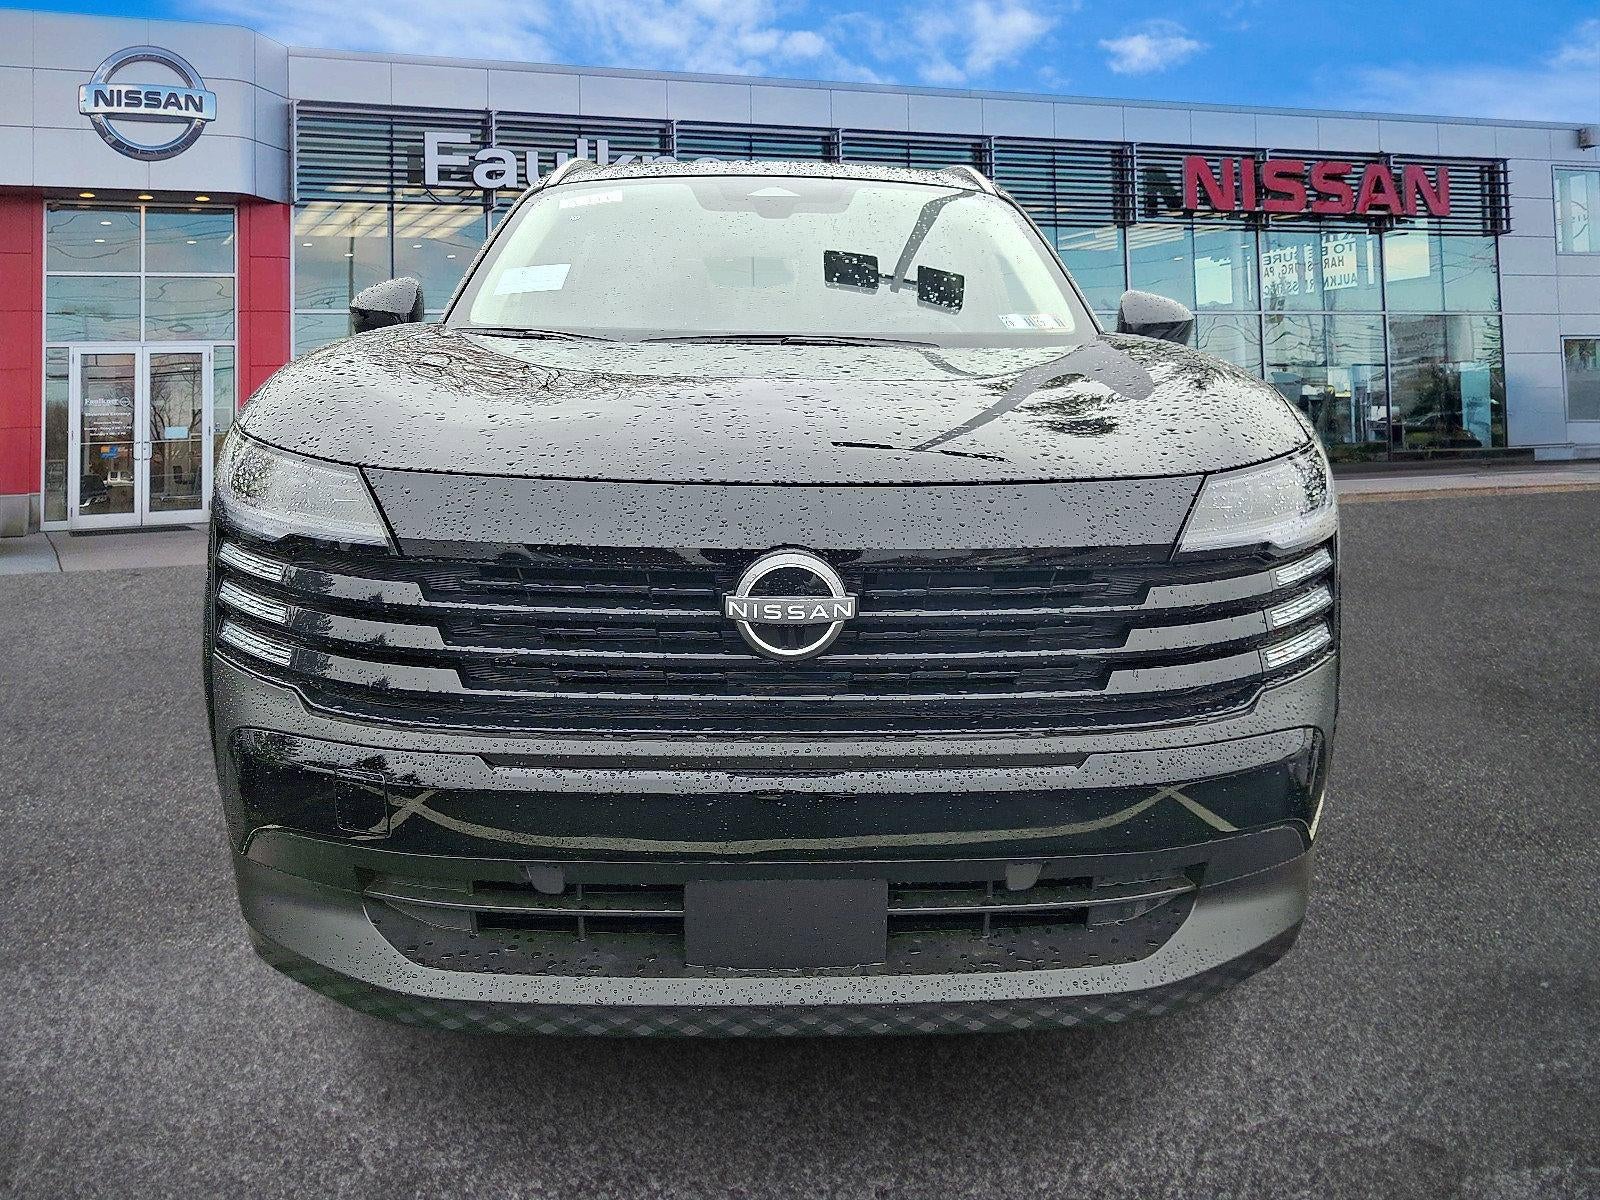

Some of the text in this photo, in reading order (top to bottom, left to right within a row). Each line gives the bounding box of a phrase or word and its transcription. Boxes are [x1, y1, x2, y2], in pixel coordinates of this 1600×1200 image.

[93, 89, 204, 113] NISSAN
[1183, 155, 1451, 217] NISSAN
[728, 601, 852, 620] NISSAN
